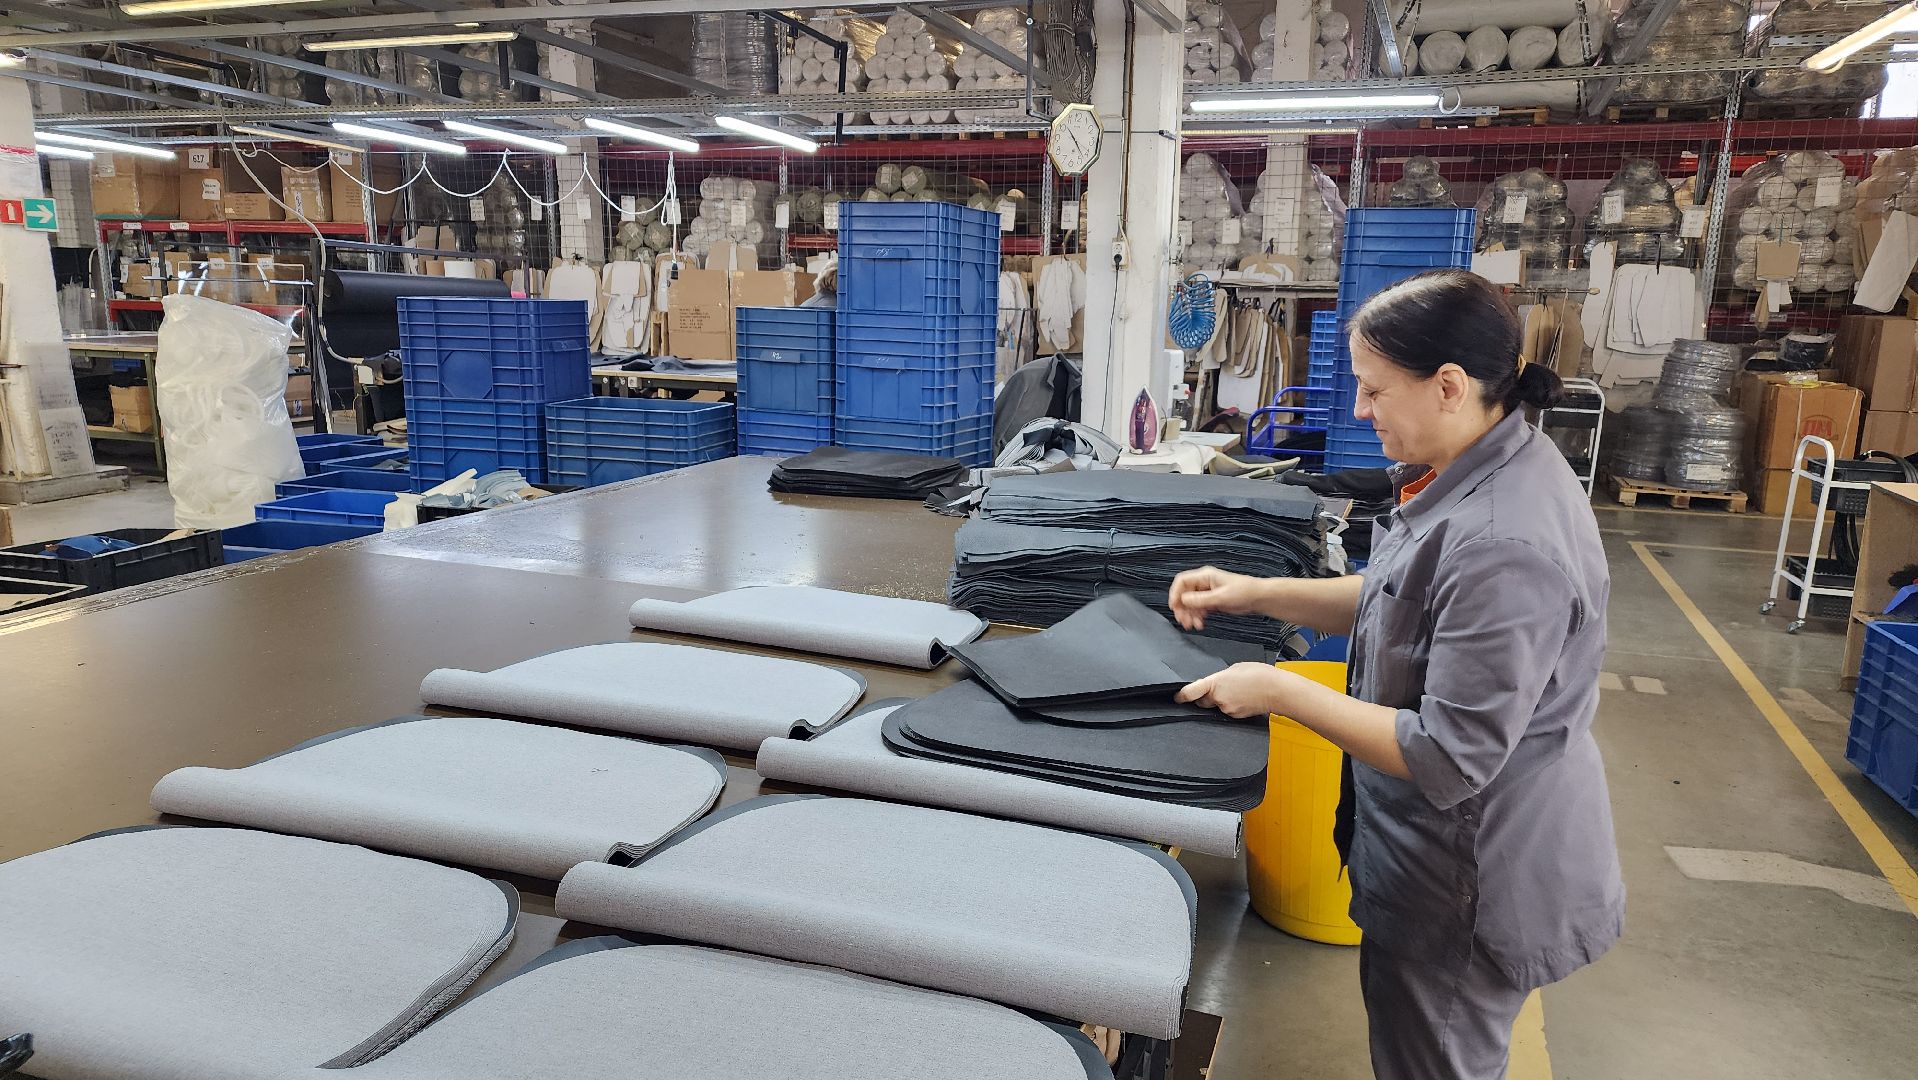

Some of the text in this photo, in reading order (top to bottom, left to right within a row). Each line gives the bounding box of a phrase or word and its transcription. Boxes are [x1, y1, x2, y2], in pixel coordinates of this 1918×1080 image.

[1075, 112, 1083, 122] 12
[1088, 125, 1093, 134] 2
[1089, 137, 1094, 146] 3
[1056, 146, 1060, 155] 8
[192, 154, 205, 163] 617
[1062, 154, 1067, 164] 7
[1068, 159, 1074, 167] 6
[1077, 155, 1082, 164] 5
